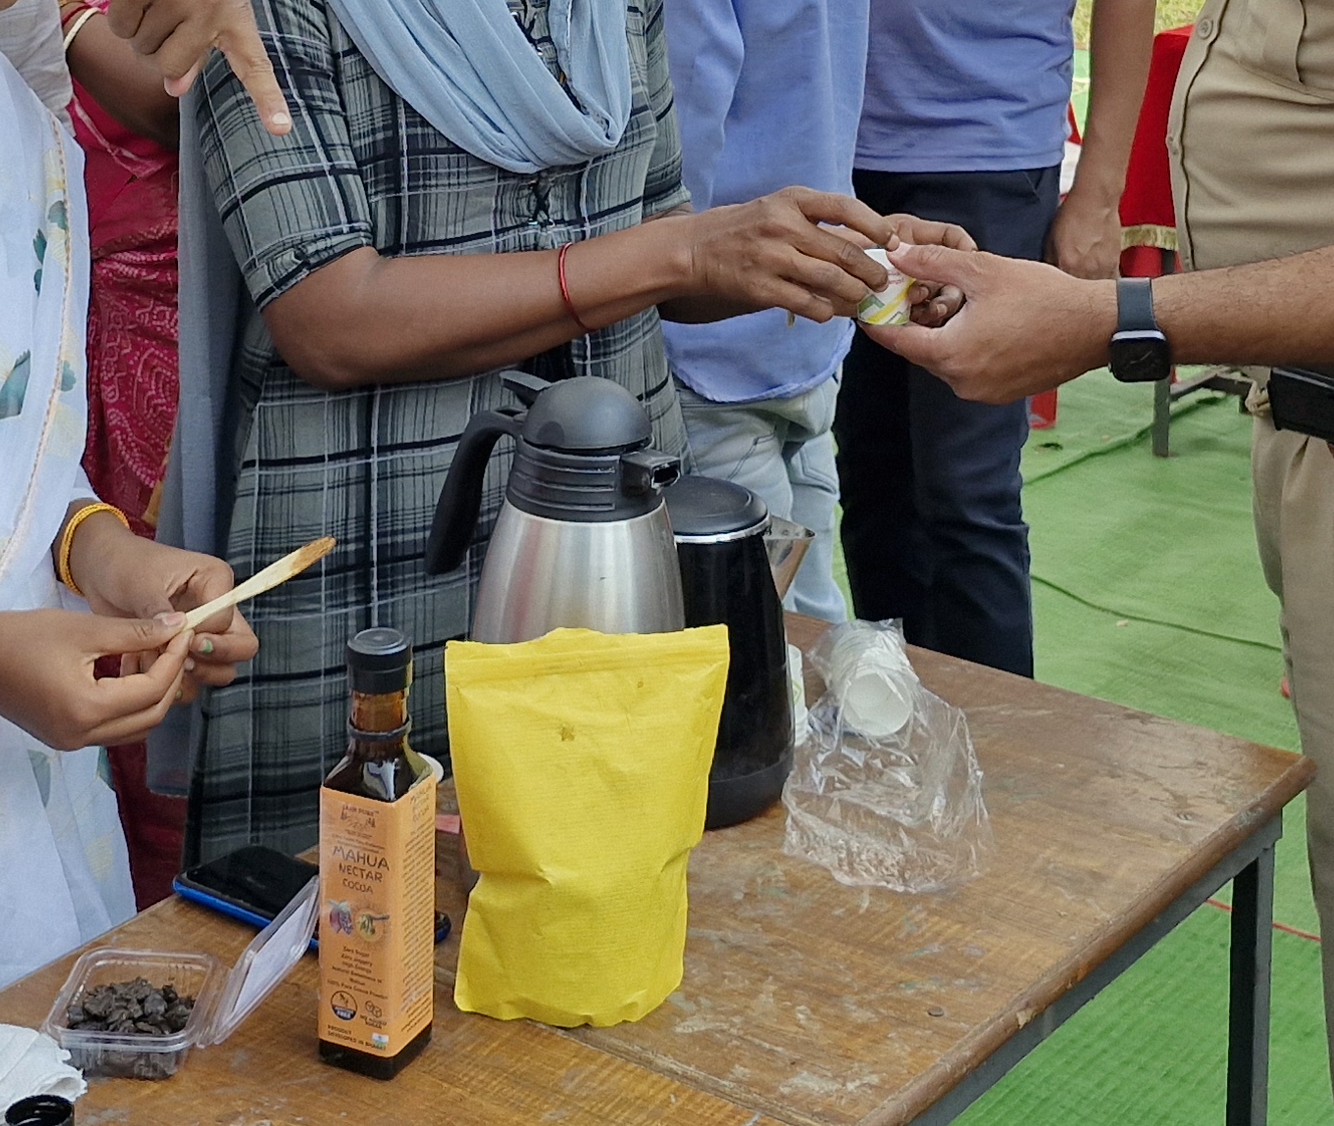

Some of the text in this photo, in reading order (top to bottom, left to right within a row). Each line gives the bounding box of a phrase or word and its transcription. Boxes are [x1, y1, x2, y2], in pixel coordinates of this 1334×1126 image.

[332, 846, 390, 871] MAHUA
[339, 862, 383, 883] NECTAR
[342, 878, 374, 894] COCOA
